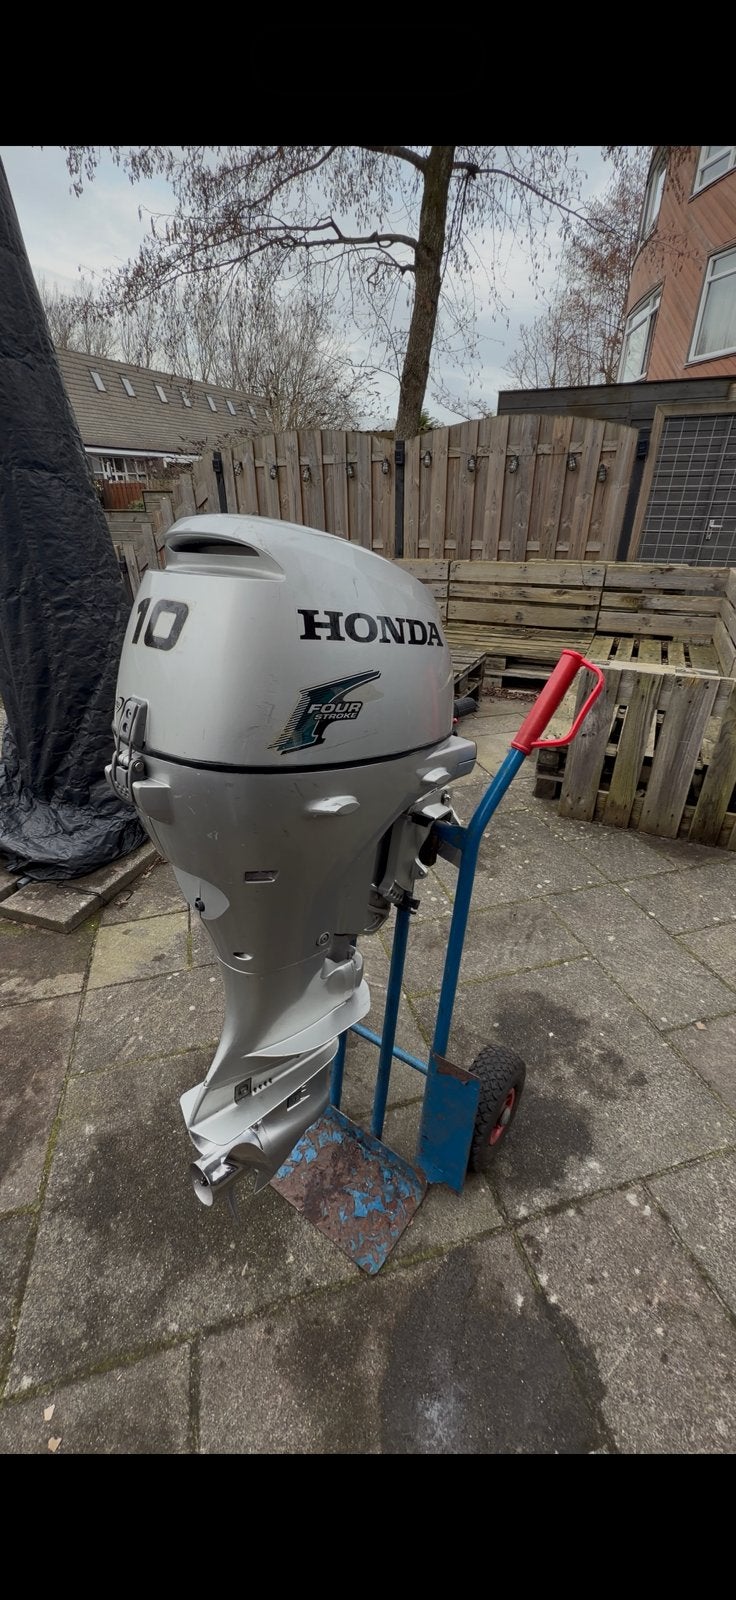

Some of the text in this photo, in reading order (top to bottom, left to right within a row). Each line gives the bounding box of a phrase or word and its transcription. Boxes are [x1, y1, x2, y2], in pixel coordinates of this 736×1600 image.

[131, 597, 189, 651] 10
[297, 609, 444, 647] HONDA
[307, 702, 362, 714] FOUR
[314, 712, 357, 720] STROKE
